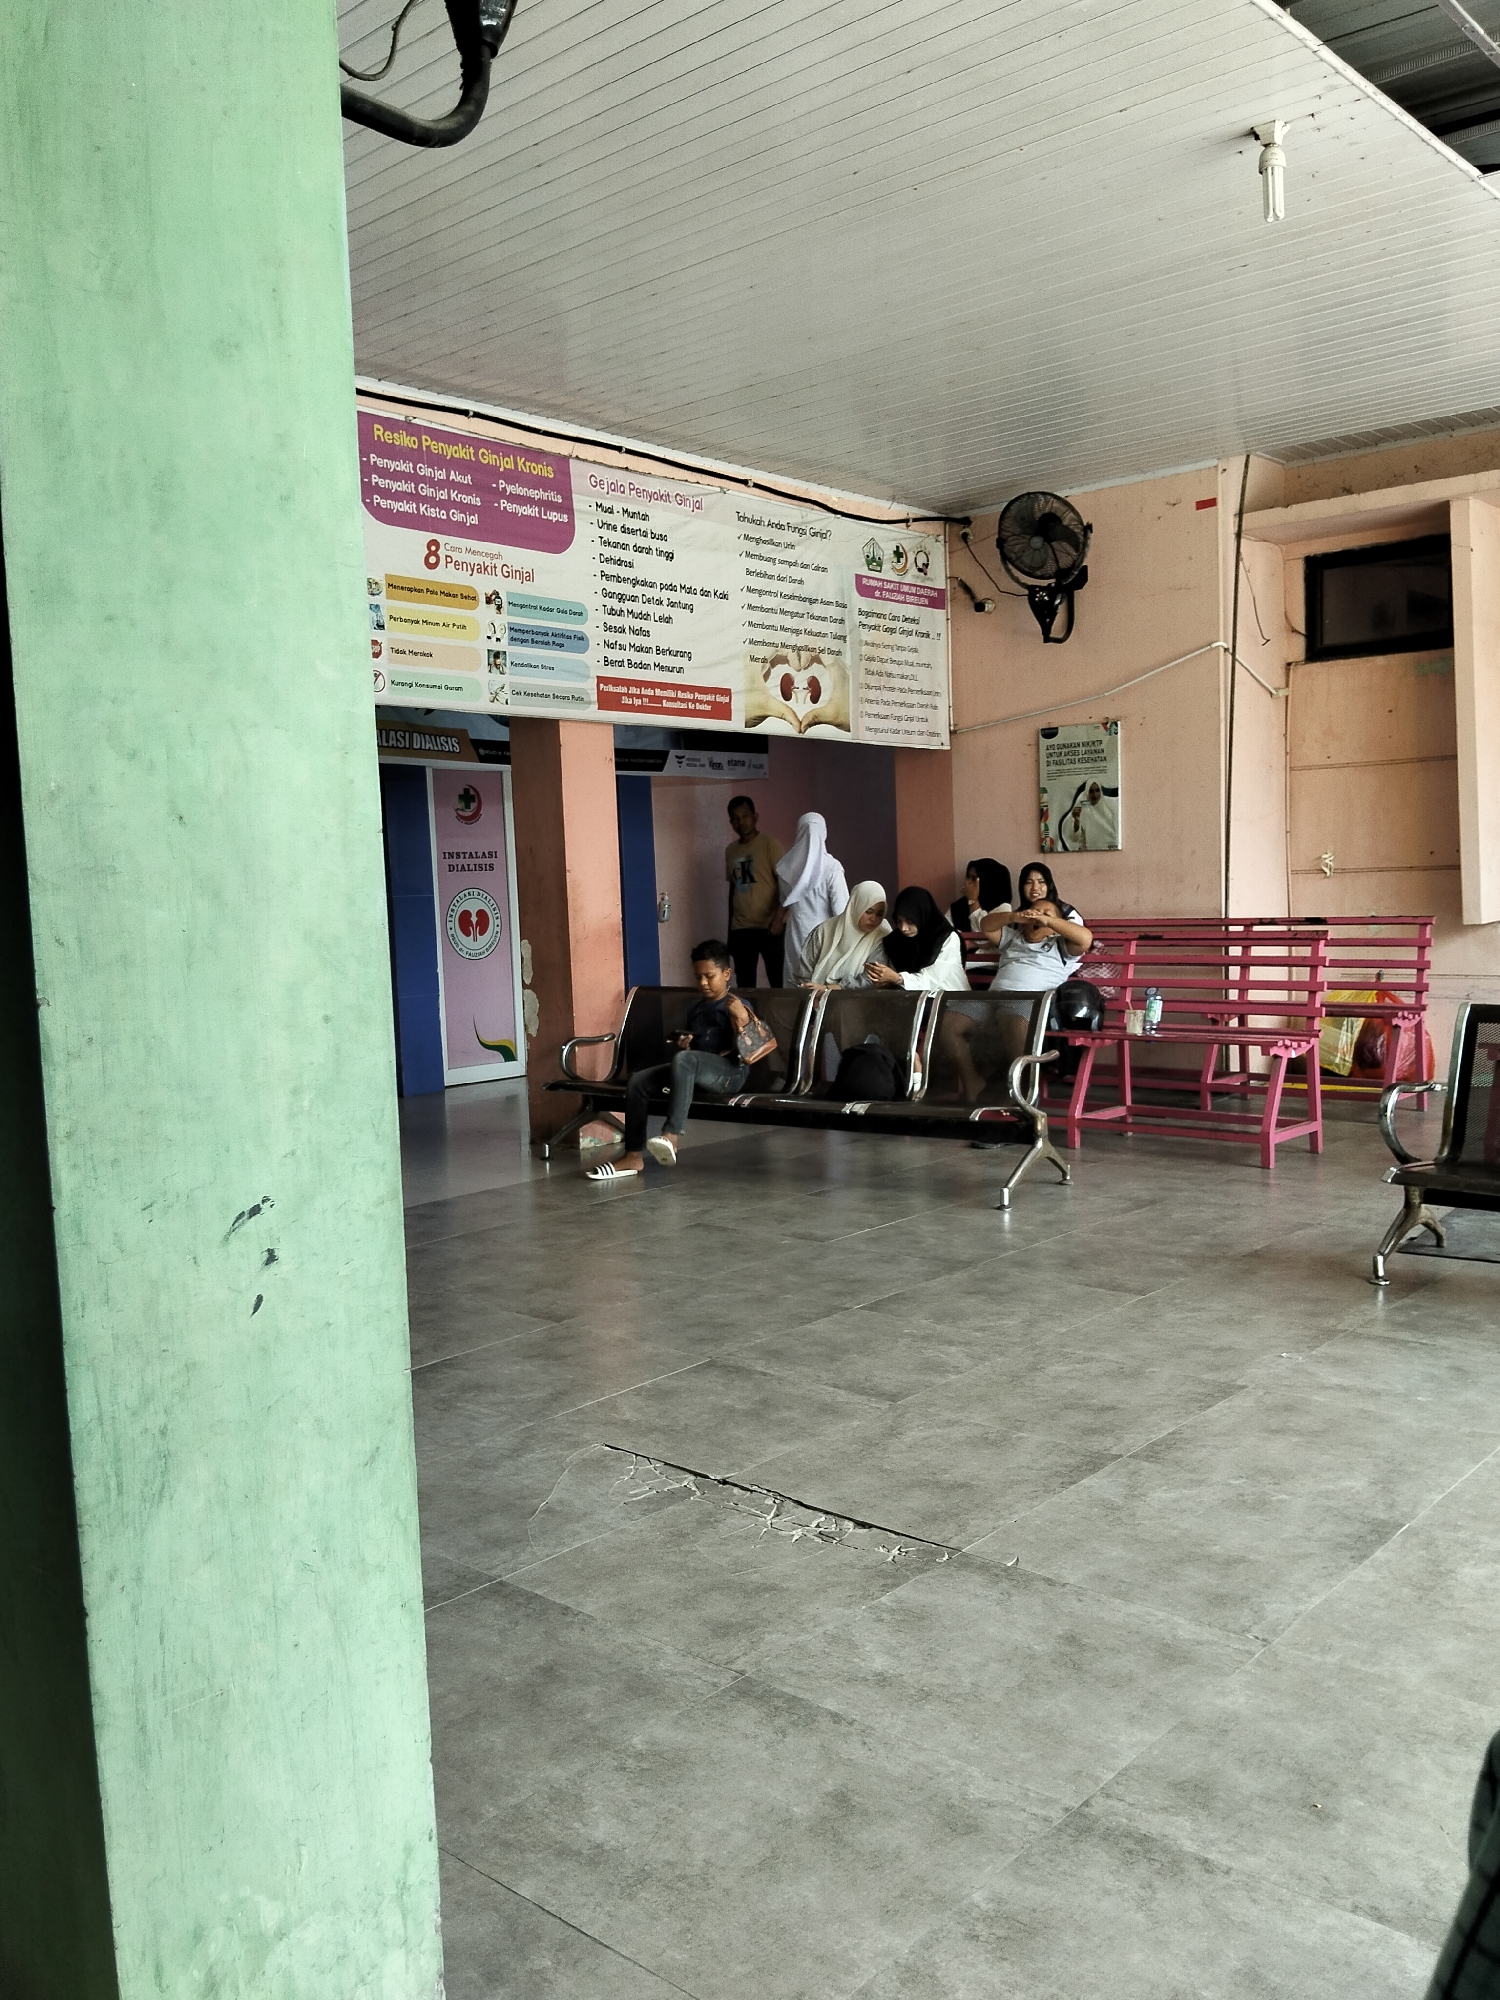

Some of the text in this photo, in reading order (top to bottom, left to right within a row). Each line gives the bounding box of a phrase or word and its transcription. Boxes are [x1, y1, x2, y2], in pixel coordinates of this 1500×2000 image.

[374, 424, 554, 478] Resiko Penyakit Ginjal Kronis
[370, 454, 472, 485] Penyakit Ginjal Akut
[372, 475, 481, 506] Penyakit Ginjal Kronis
[499, 480, 563, 503] Pyelonephritis
[589, 474, 704, 512] Gejala Penyakit Ginjal
[374, 496, 479, 526] Penyakit Kista Ginjal
[500, 501, 568, 523] Penyakit Lupus
[595, 502, 649, 521] Mual Muntah
[597, 519, 668, 542] Urine disertai busa
[736, 511, 832, 541] Tahukah Anda Fungsi Ginjal?
[598, 536, 674, 561] Tekanan darah tinggi
[743, 534, 795, 550] Menghasilkan Urin
[424, 539, 440, 570] 8
[444, 543, 503, 561] Cara Mencegah
[599, 554, 634, 568] Dehidrasi
[745, 551, 776, 566] Membuang
[778, 559, 799, 568] sampah
[800, 561, 810, 570] dan
[445, 555, 535, 584] Penyakit Ginjal
[746, 568, 804, 585] Berlebihan dari Darah
[388, 583, 424, 596] Menerapkan
[440, 590, 459, 600] Makan
[460, 592, 477, 601] Sehat
[600, 571, 729, 600] Pembengkakan pada Mata dan Kaki
[746, 586, 778, 598] Mengontrol
[862, 578, 882, 588] RUMAH
[884, 582, 899, 590] SAKIT
[917, 587, 938, 597] DAERAH
[602, 588, 694, 613] Gangguan Detak Jantung
[389, 615, 467, 631] Perbanyak Minum Air Putih
[602, 605, 673, 624] Tubuh Mudah Lelah
[747, 604, 845, 625] Membantu Mengatur Tekanan Darah
[603, 622, 650, 637] Sesak Nafas
[748, 621, 778, 631] Membantu
[780, 625, 802, 637] Menjaga
[859, 621, 881, 632] Penyakit
[390, 647, 407, 656] Tidak
[408, 650, 433, 658] Merokok
[604, 639, 692, 661] Nafsu Makan Berkurang
[749, 638, 779, 648] Membantu
[604, 656, 684, 674] Berat Badan Menurun
[391, 680, 463, 692] Kurangi Konsumsi Garam
[523, 691, 550, 700] Kesehatan
[413, 732, 460, 752] DIALISIS
[443, 851, 498, 860] INSTALASI
[448, 863, 494, 872] DIALISIS
[448, 891, 499, 922] INSTALASI DIALISIS
